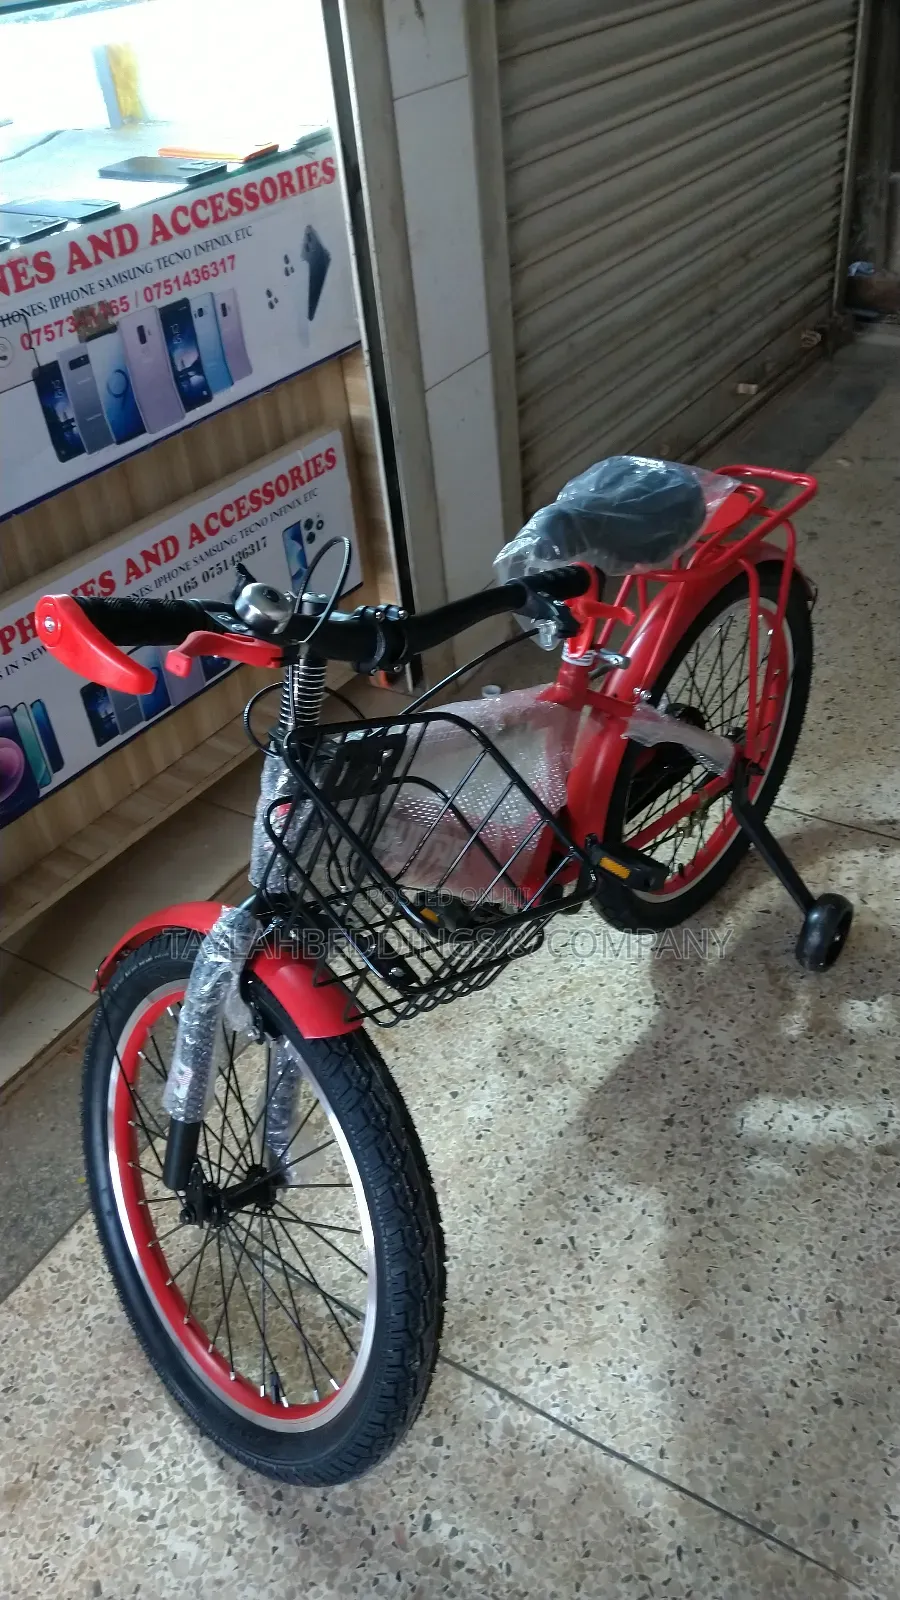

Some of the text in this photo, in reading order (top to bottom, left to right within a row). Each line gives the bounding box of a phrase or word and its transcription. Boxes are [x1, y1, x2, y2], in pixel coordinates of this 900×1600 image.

[67, 223, 139, 275] AND
[150, 157, 336, 246] ACCESSORIES
[48, 282, 97, 310] IPHONE
[97, 261, 153, 292] SAMSUNG
[155, 248, 192, 270] TECNO
[193, 233, 234, 257] INFINIX
[234, 226, 253, 241] ETC
[143, 254, 236, 303] 0751436317
[124, 535, 180, 586] AND
[188, 447, 337, 550] ACCESSORIES
[201, 535, 268, 584] 0751436317
[4, 660, 20, 677] IN
[153, 561, 193, 589] IPHONE
[192, 534, 238, 566] SAMSUNG
[239, 517, 269, 540] TECNO
[303, 487, 319, 503] ETC
